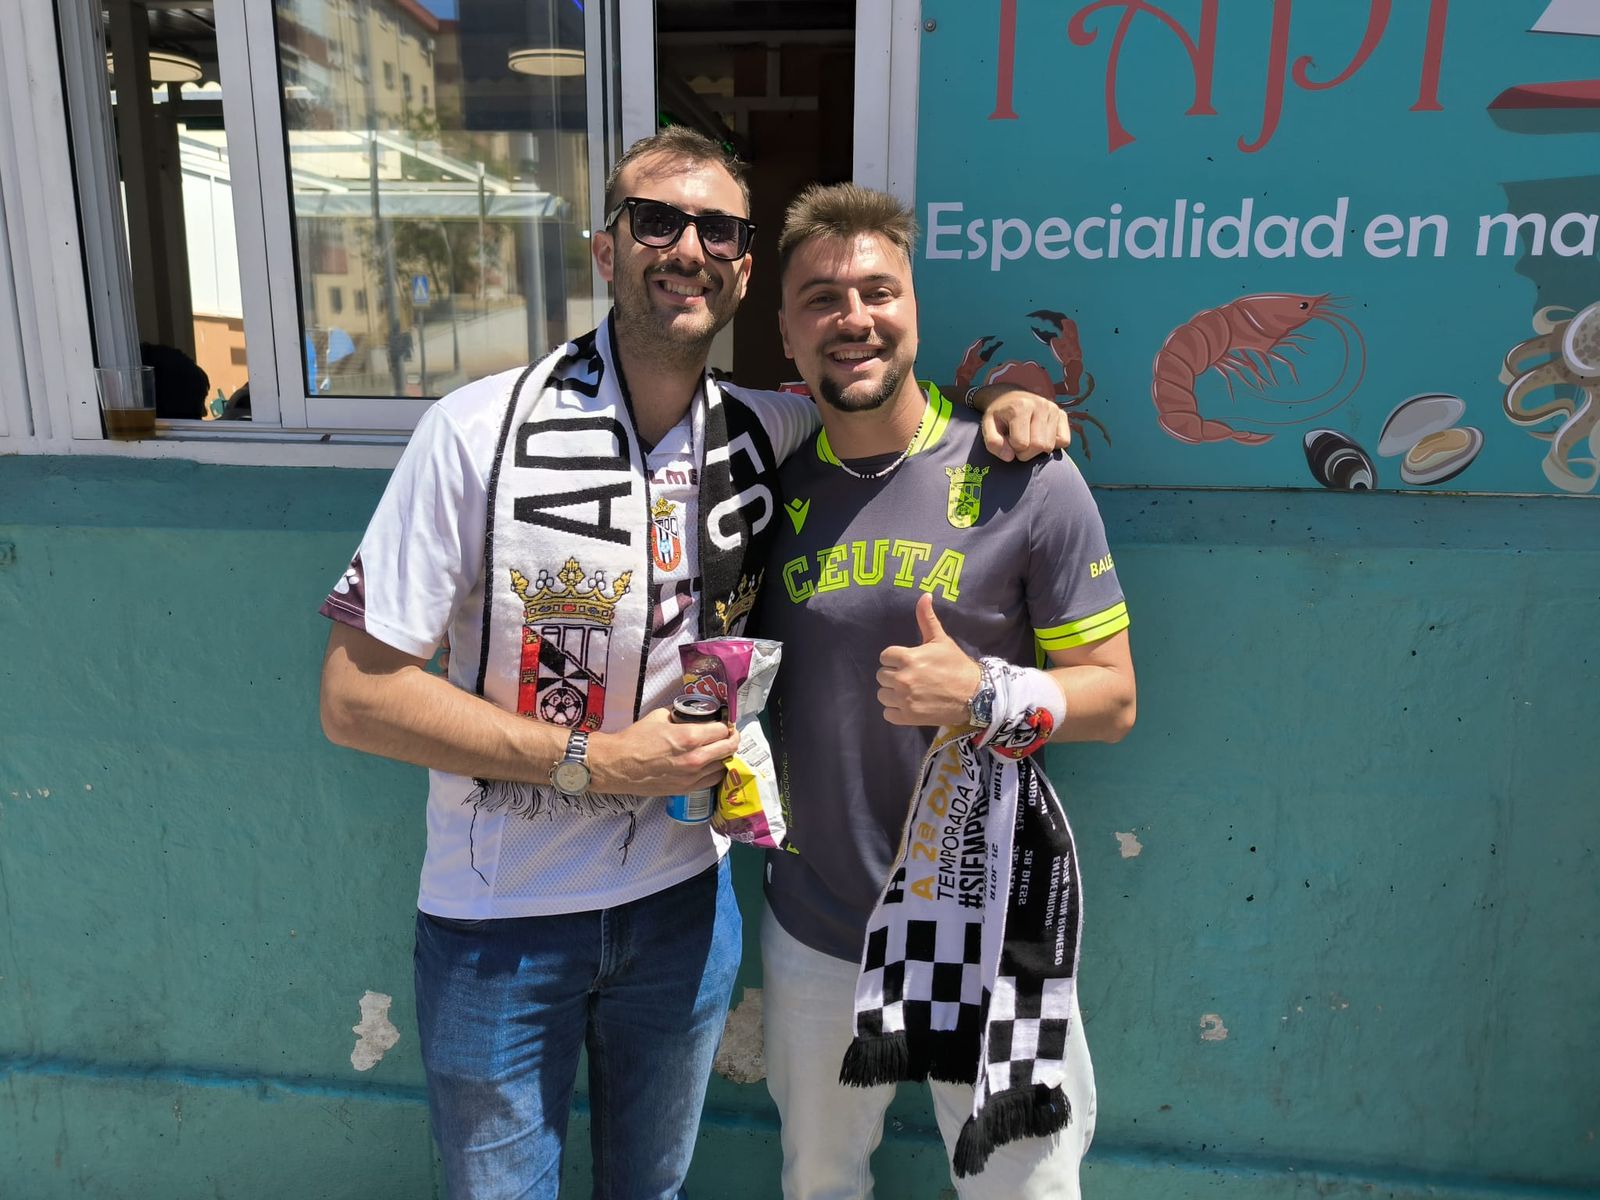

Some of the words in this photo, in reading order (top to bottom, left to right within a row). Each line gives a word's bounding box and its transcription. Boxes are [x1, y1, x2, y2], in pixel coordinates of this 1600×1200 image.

[925, 197, 1349, 271] Especialidad
[1364, 214, 1448, 258] en
[1476, 212, 1599, 257] ma
[514, 416, 631, 546] AD
[777, 539, 965, 604] CEUTA
[1090, 552, 1114, 578] BALE
[937, 785, 973, 900] TEMPORADA
